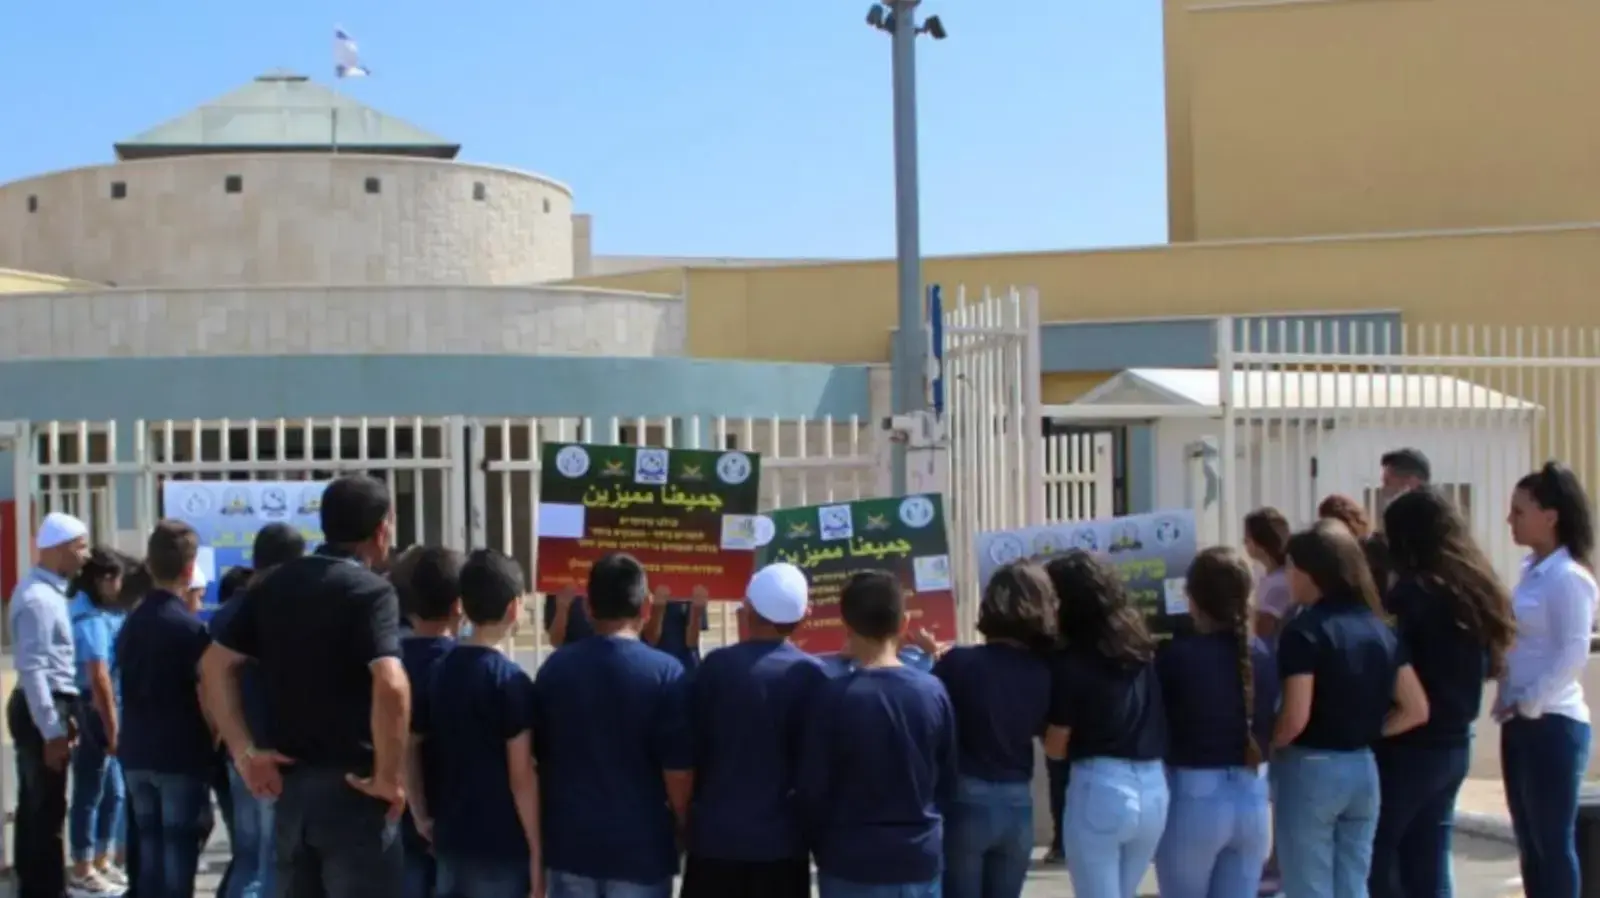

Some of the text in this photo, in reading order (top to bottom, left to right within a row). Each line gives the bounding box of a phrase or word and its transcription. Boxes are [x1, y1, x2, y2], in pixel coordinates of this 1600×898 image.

[582, 484, 723, 512] جميعنا مميزين
[849, 537, 912, 560] جميعنا
